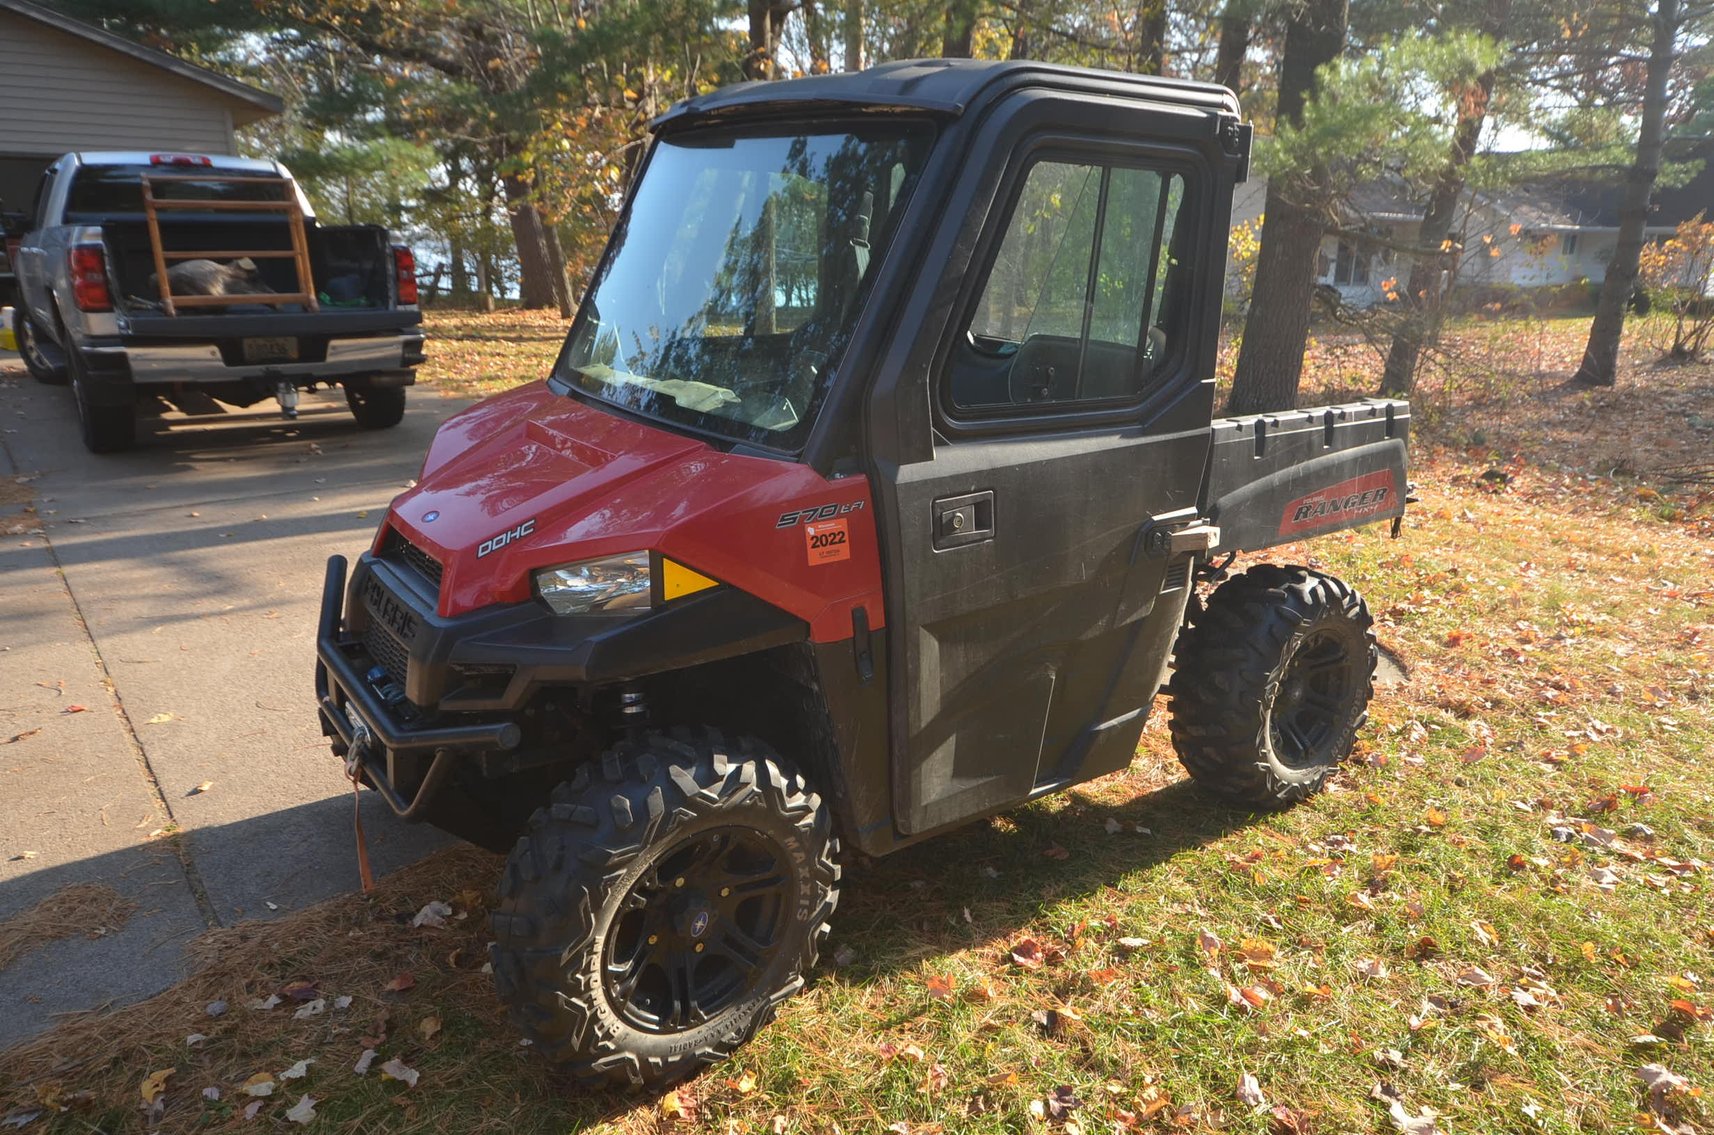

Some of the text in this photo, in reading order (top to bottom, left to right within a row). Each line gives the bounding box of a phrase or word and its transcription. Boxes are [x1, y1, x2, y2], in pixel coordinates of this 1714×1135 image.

[776, 503, 840, 528] 570
[840, 500, 864, 513] EFI
[1291, 487, 1389, 523] RANGER
[477, 518, 536, 559] DOHC
[810, 531, 846, 549] 2022
[364, 574, 418, 639] POLARIS
[784, 836, 811, 921] MAXXIS
[590, 935, 623, 1038] BIGHORN
